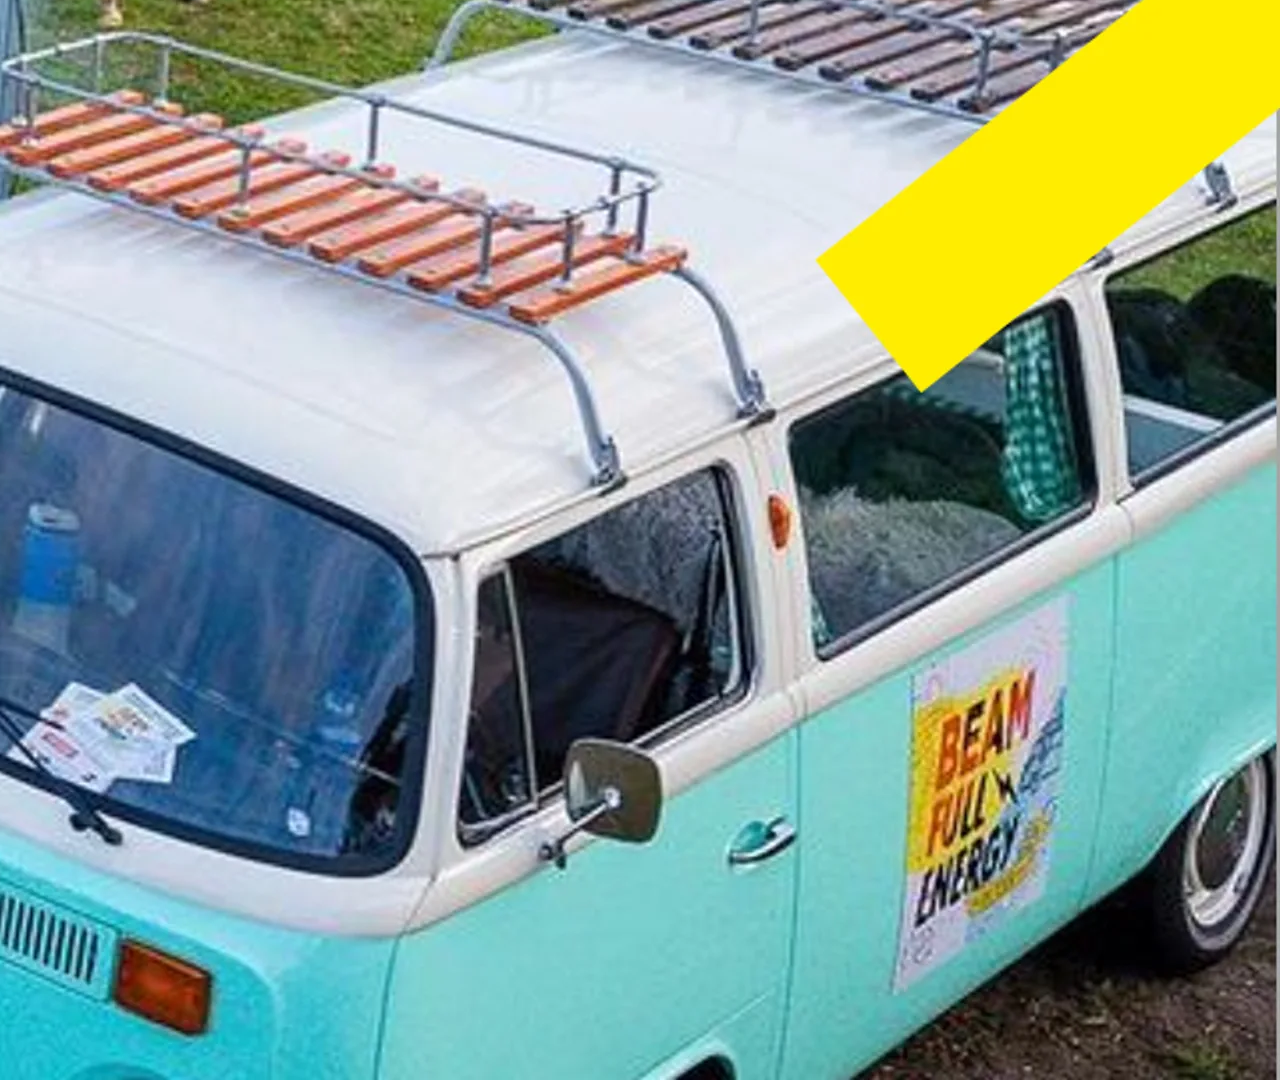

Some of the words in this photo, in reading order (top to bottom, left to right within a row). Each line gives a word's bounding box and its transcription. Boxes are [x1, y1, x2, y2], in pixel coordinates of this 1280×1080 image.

[935, 669, 1036, 792] BEAM
[913, 810, 1021, 928] ENERGY
[925, 770, 989, 858] FULL
